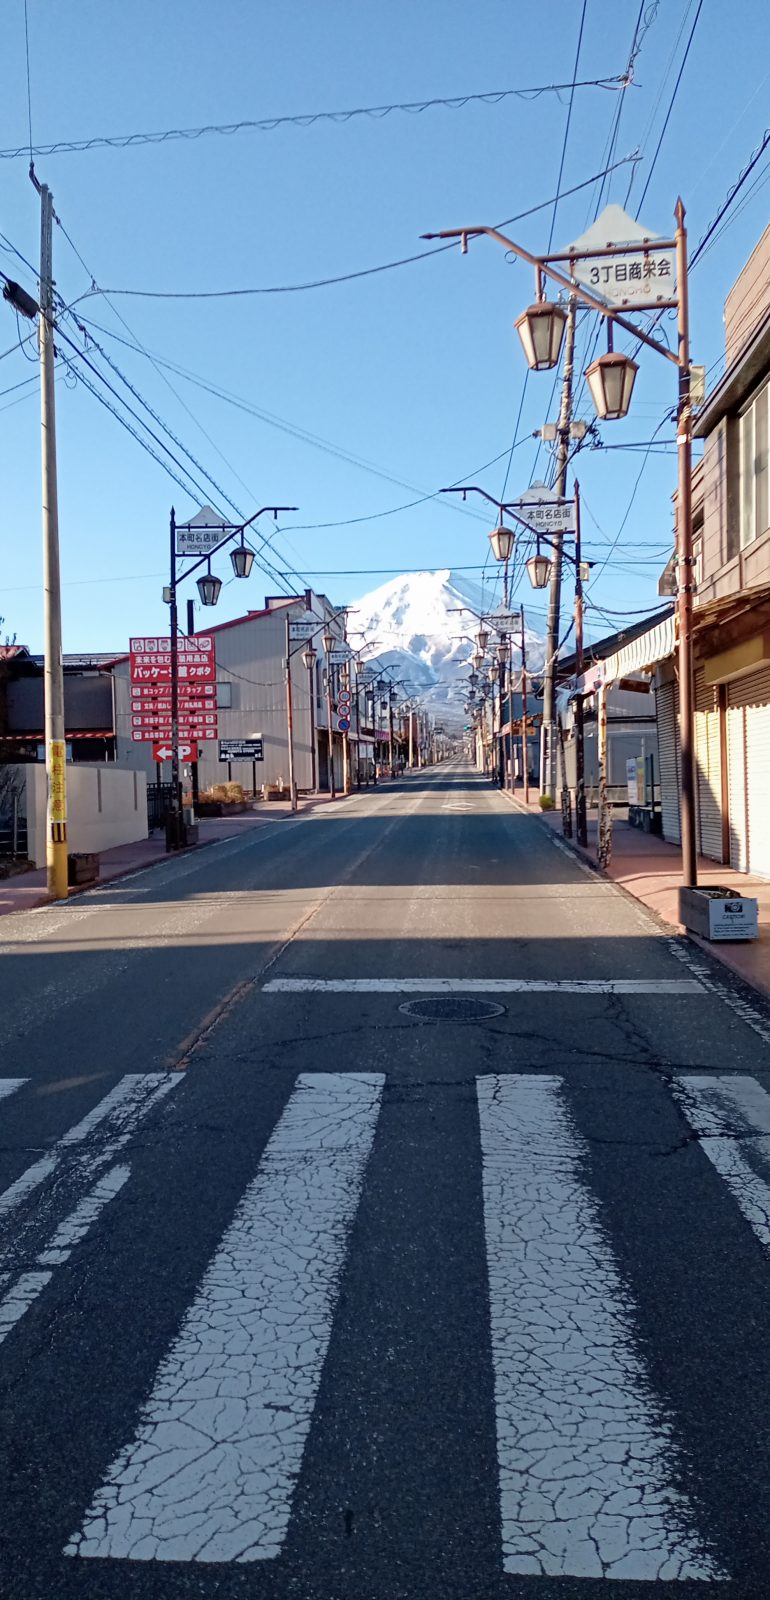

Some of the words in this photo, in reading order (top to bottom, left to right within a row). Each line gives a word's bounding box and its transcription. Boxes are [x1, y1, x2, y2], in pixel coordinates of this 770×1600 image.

[590, 258, 671, 285] 3丁目商栄会
[527, 508, 571, 520] 本町名店街
[179, 533, 218, 543] 本町名店街
[135, 655, 209, 664] 未来を包む装用品店
[189, 666, 211, 676] クボタ
[178, 746, 191, 759] P
